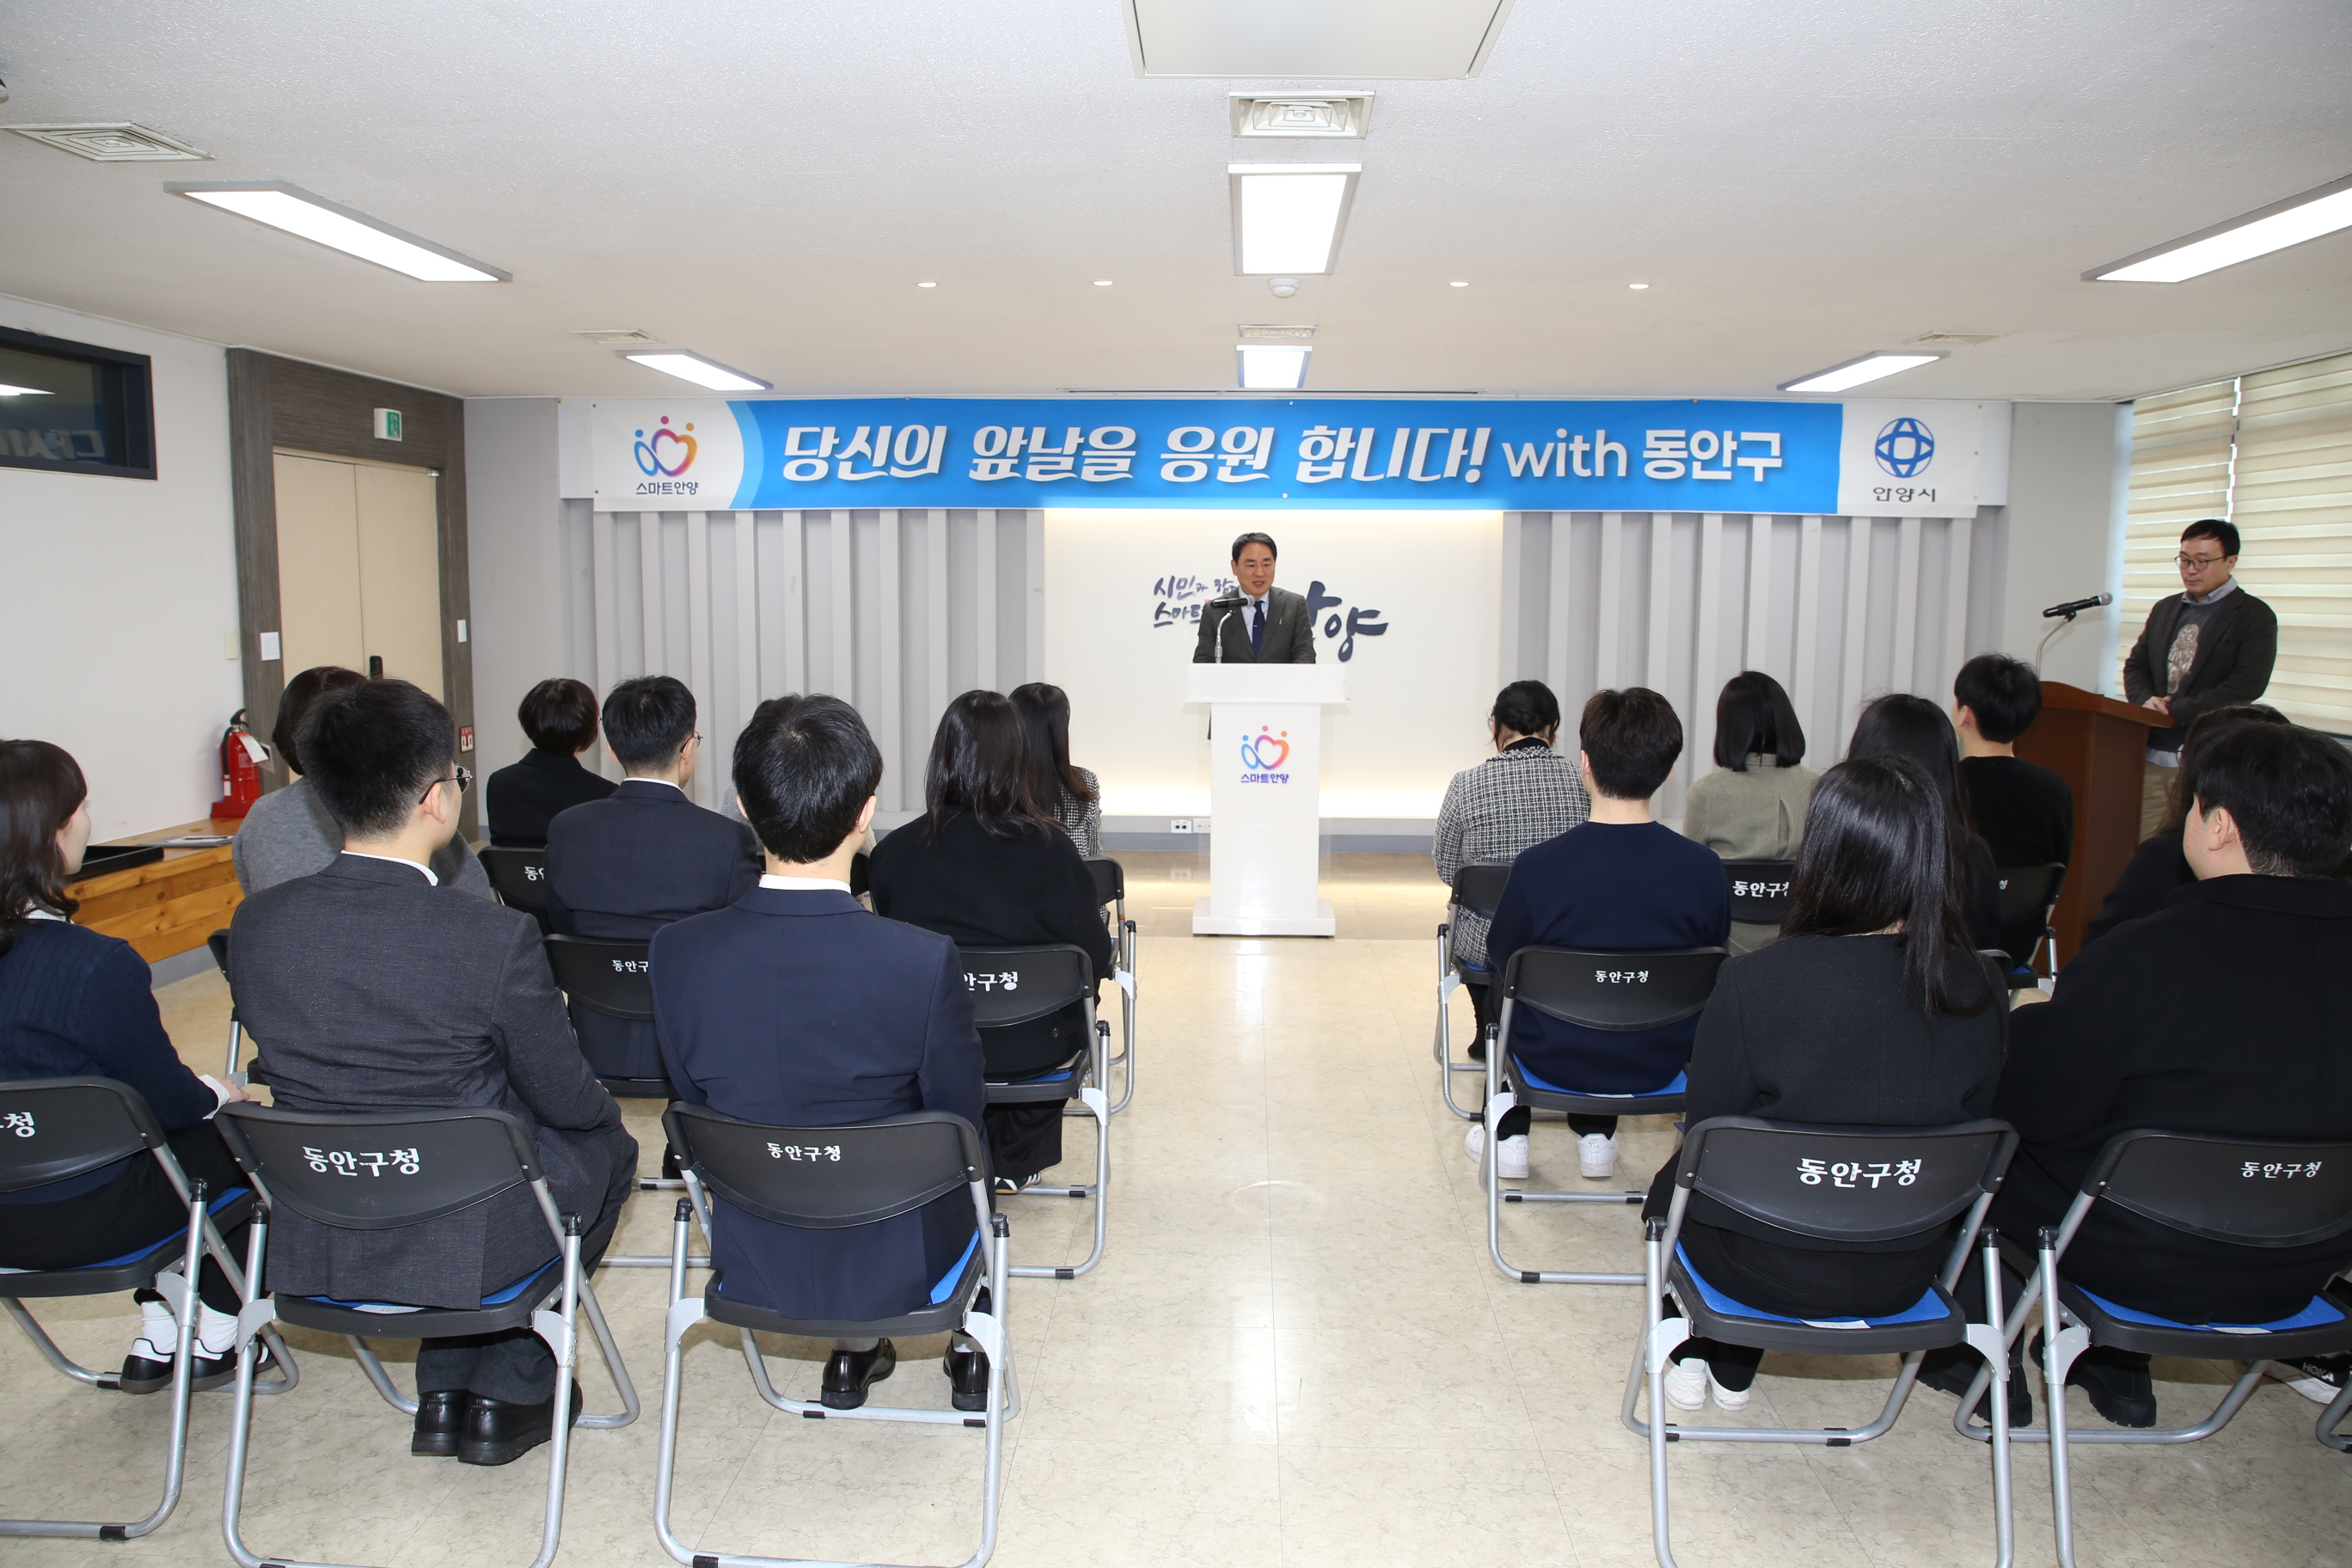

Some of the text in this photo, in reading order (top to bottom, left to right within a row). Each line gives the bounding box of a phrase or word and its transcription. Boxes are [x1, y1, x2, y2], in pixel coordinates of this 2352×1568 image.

[783, 425, 1783, 483] 당신의 앞날을 응원 합니다! with 동안구
[635, 481, 699, 495] 스마트안양
[1872, 487, 1935, 503] 안양시
[1154, 575, 1208, 600] 시민과
[1240, 773, 1289, 784] 스마트안양
[612, 959, 649, 973] 동안구
[1595, 970, 1649, 983] 동안구청
[766, 1142, 842, 1162] 동안구청
[302, 1146, 420, 1178] 동안구청
[2240, 1161, 2322, 1179] 동안구청
[1796, 1157, 1922, 1190] 동안구청
